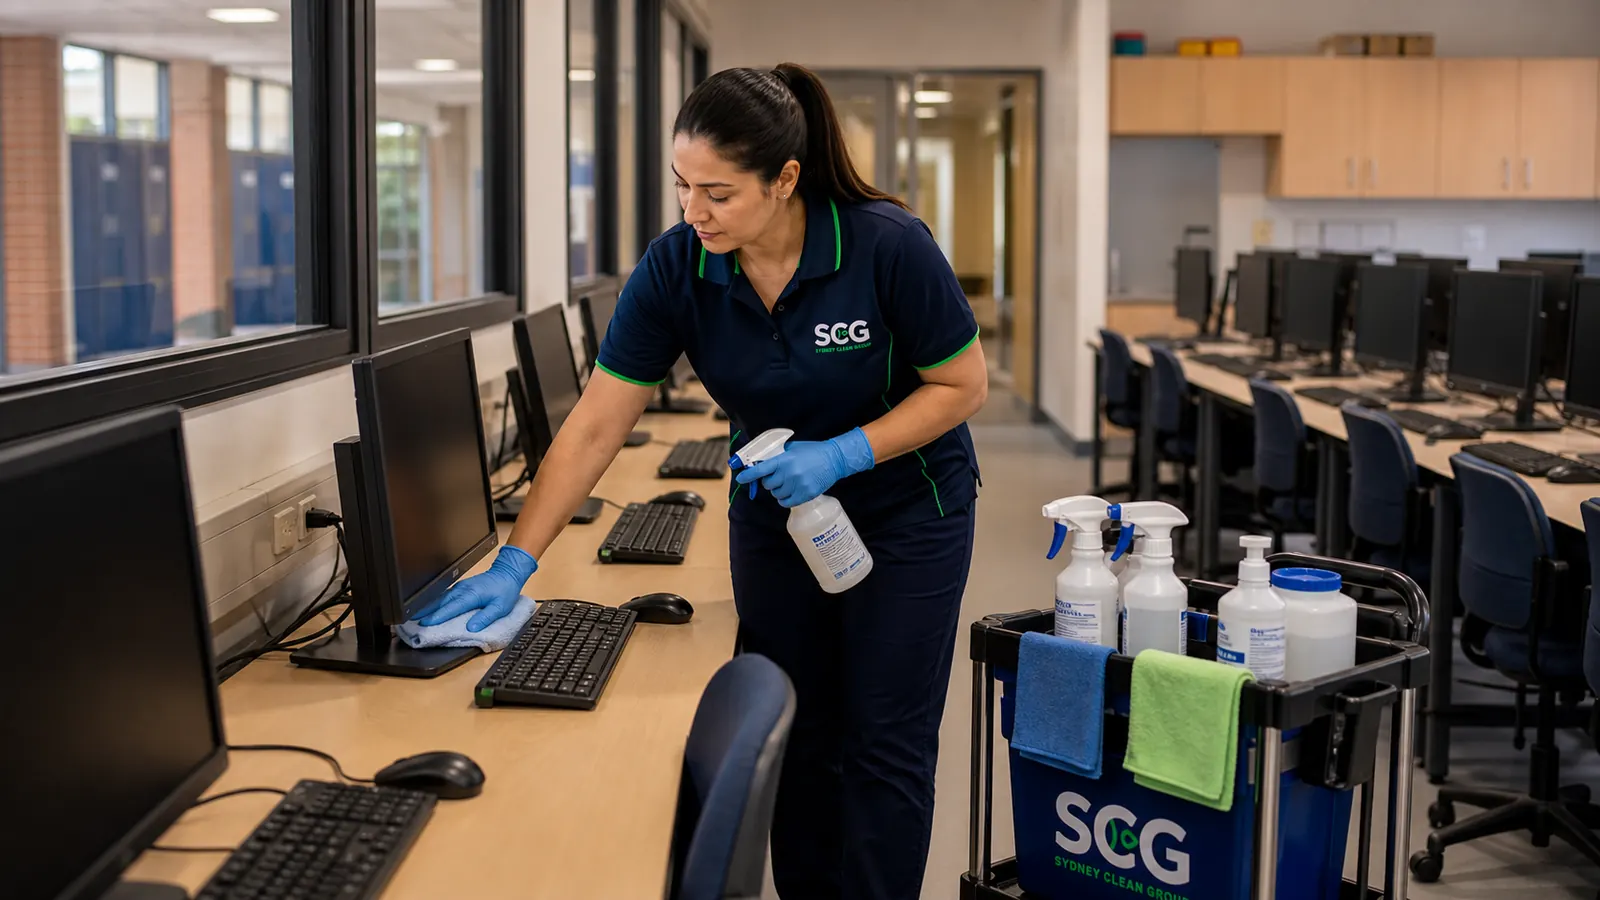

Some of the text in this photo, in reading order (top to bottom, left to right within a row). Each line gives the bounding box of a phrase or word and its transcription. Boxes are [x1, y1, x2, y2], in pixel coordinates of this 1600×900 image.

[814, 320, 870, 346] SCG
[1055, 791, 1190, 885] SCG
[1054, 855, 1190, 900] SYDNEY CLEAN GRO
